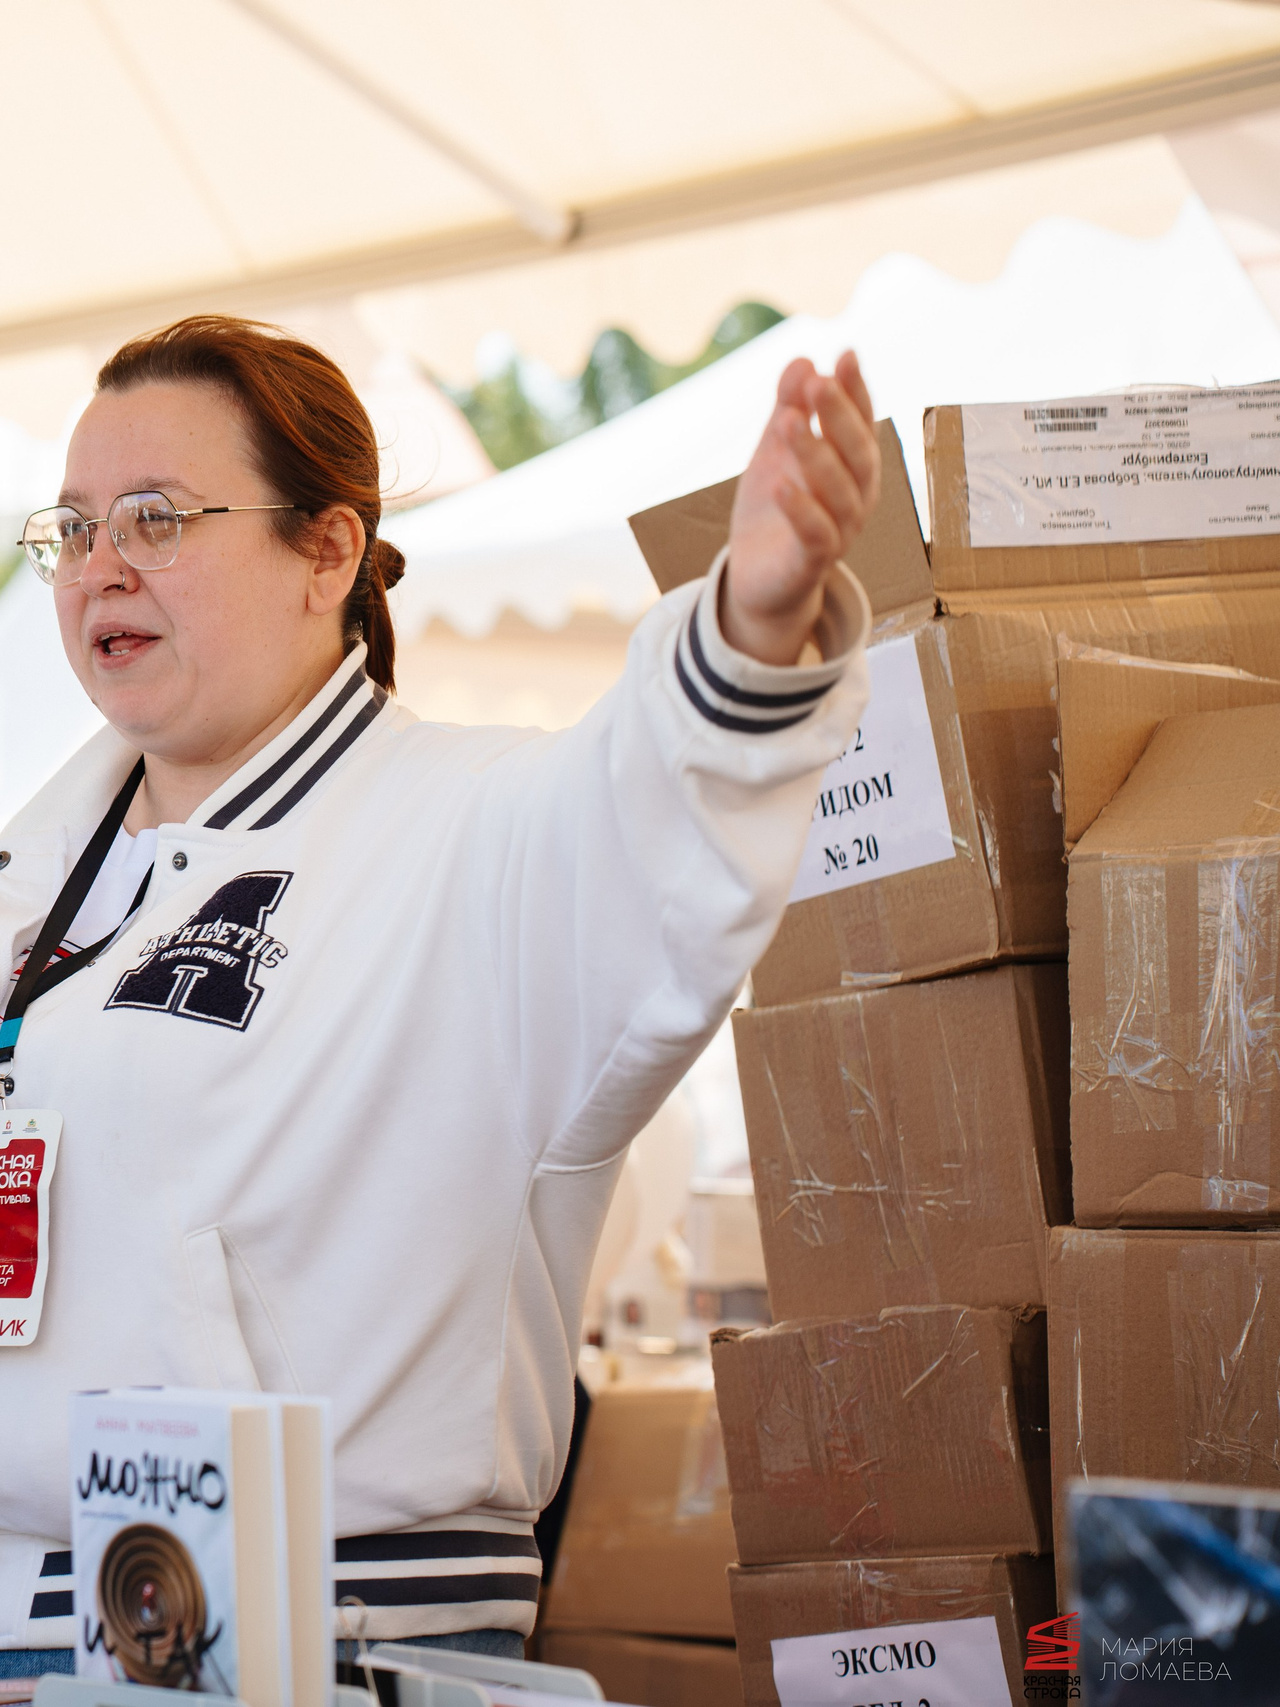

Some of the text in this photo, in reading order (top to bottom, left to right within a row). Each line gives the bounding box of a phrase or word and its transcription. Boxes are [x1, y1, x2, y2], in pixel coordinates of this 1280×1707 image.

[1121, 451, 1208, 469] Екатеринбург
[1084, 471, 1140, 486] Боброва
[854, 727, 865, 752] 2
[824, 833, 880, 875] № 20
[138, 912, 289, 969] ATHLETIC
[159, 946, 241, 968] DEPARTMENT
[832, 1640, 937, 1678] ЭКСМО
